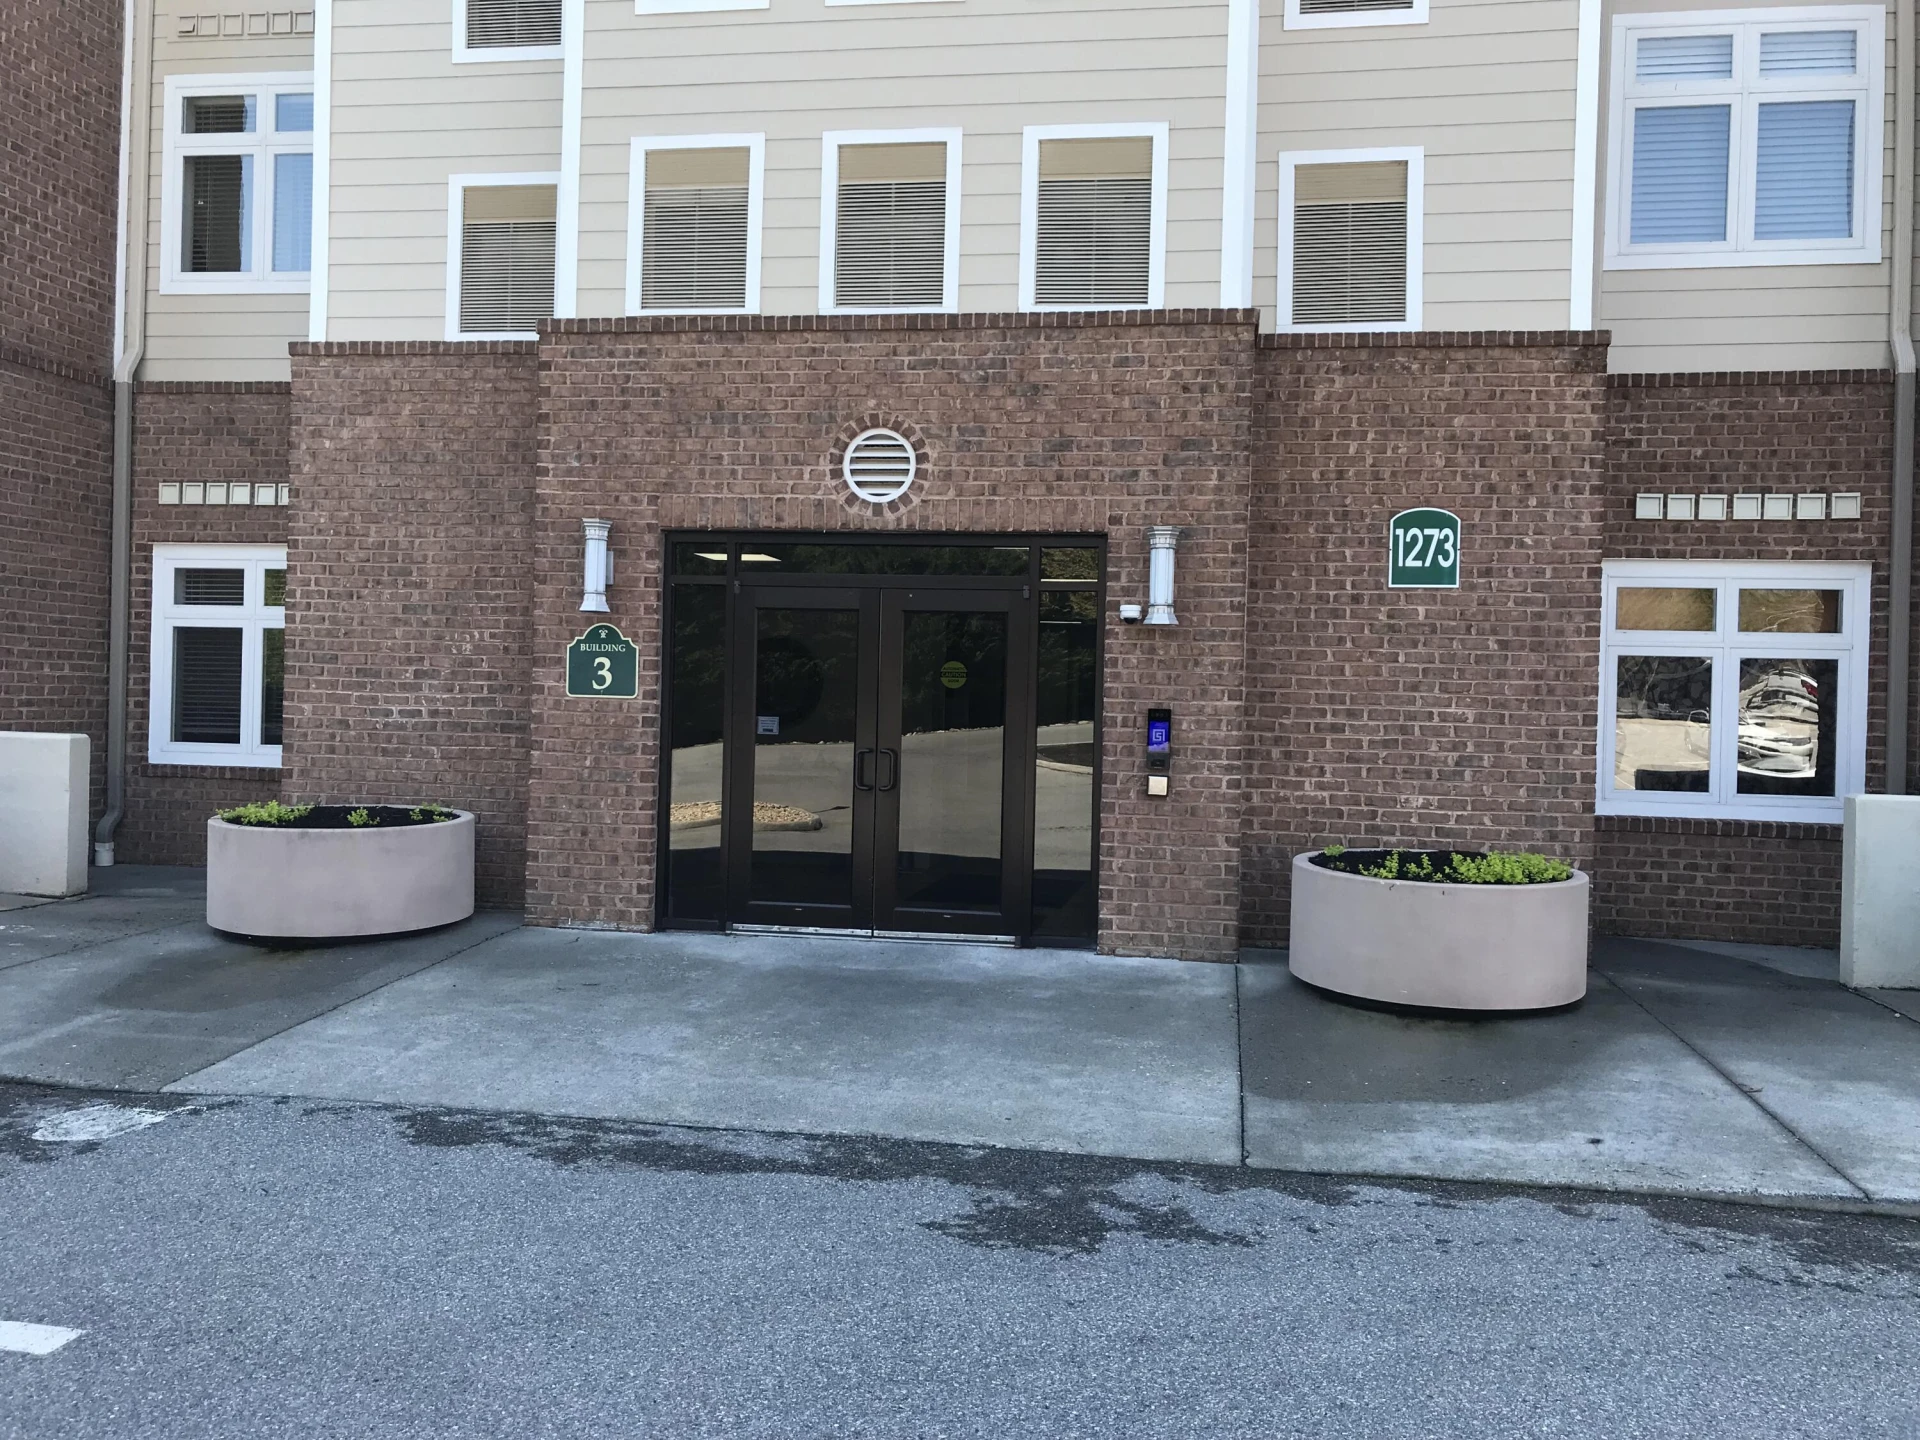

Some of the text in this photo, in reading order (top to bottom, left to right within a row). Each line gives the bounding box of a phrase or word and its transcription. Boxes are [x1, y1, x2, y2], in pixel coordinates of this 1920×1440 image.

[1395, 527, 1455, 568] 1273
[580, 643, 626, 652] BUILDING
[591, 656, 612, 690] 3
